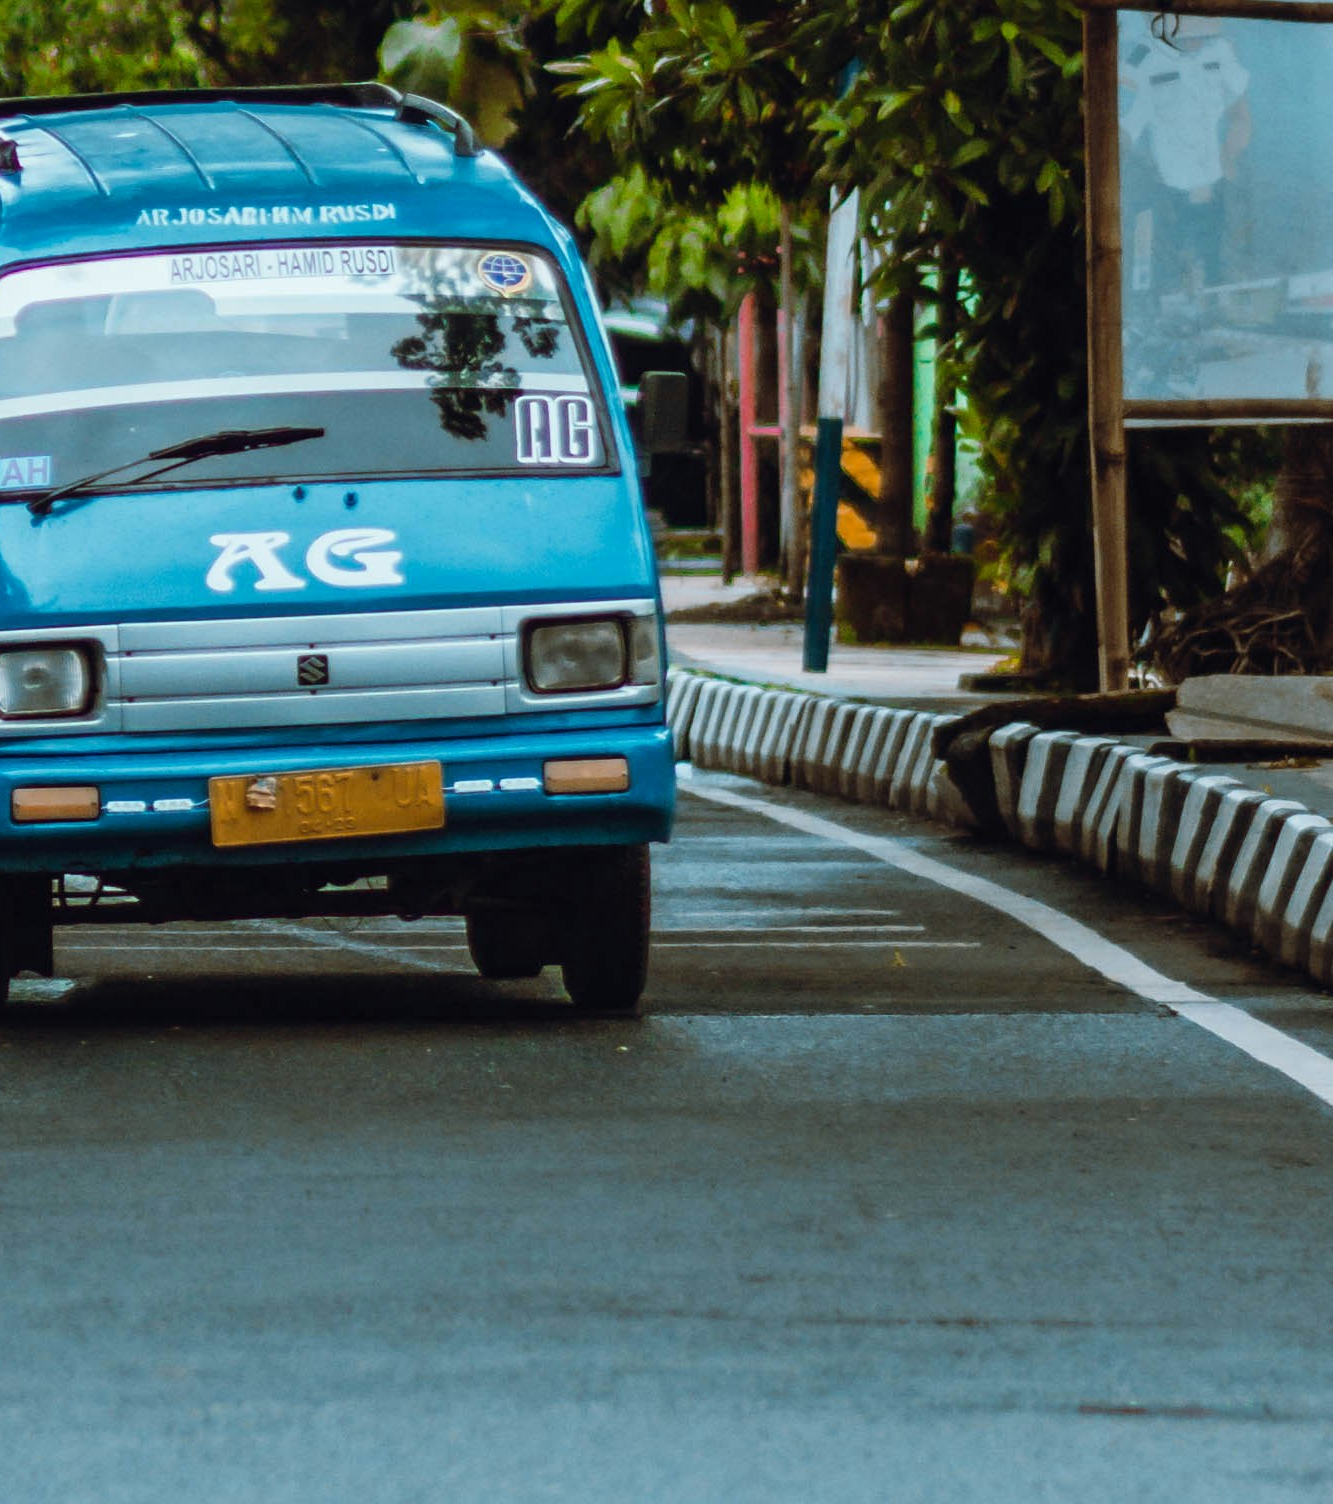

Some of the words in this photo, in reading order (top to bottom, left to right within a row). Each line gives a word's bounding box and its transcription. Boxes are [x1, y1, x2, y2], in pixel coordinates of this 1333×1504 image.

[319, 203, 397, 224] RUSDI
[171, 254, 261, 281] ARJOSARI
[277, 251, 334, 277] HAMID
[341, 249, 396, 274] RUSDI
[1, 458, 51, 487] AH
[205, 528, 404, 592] AG
[389, 764, 435, 810] UA
